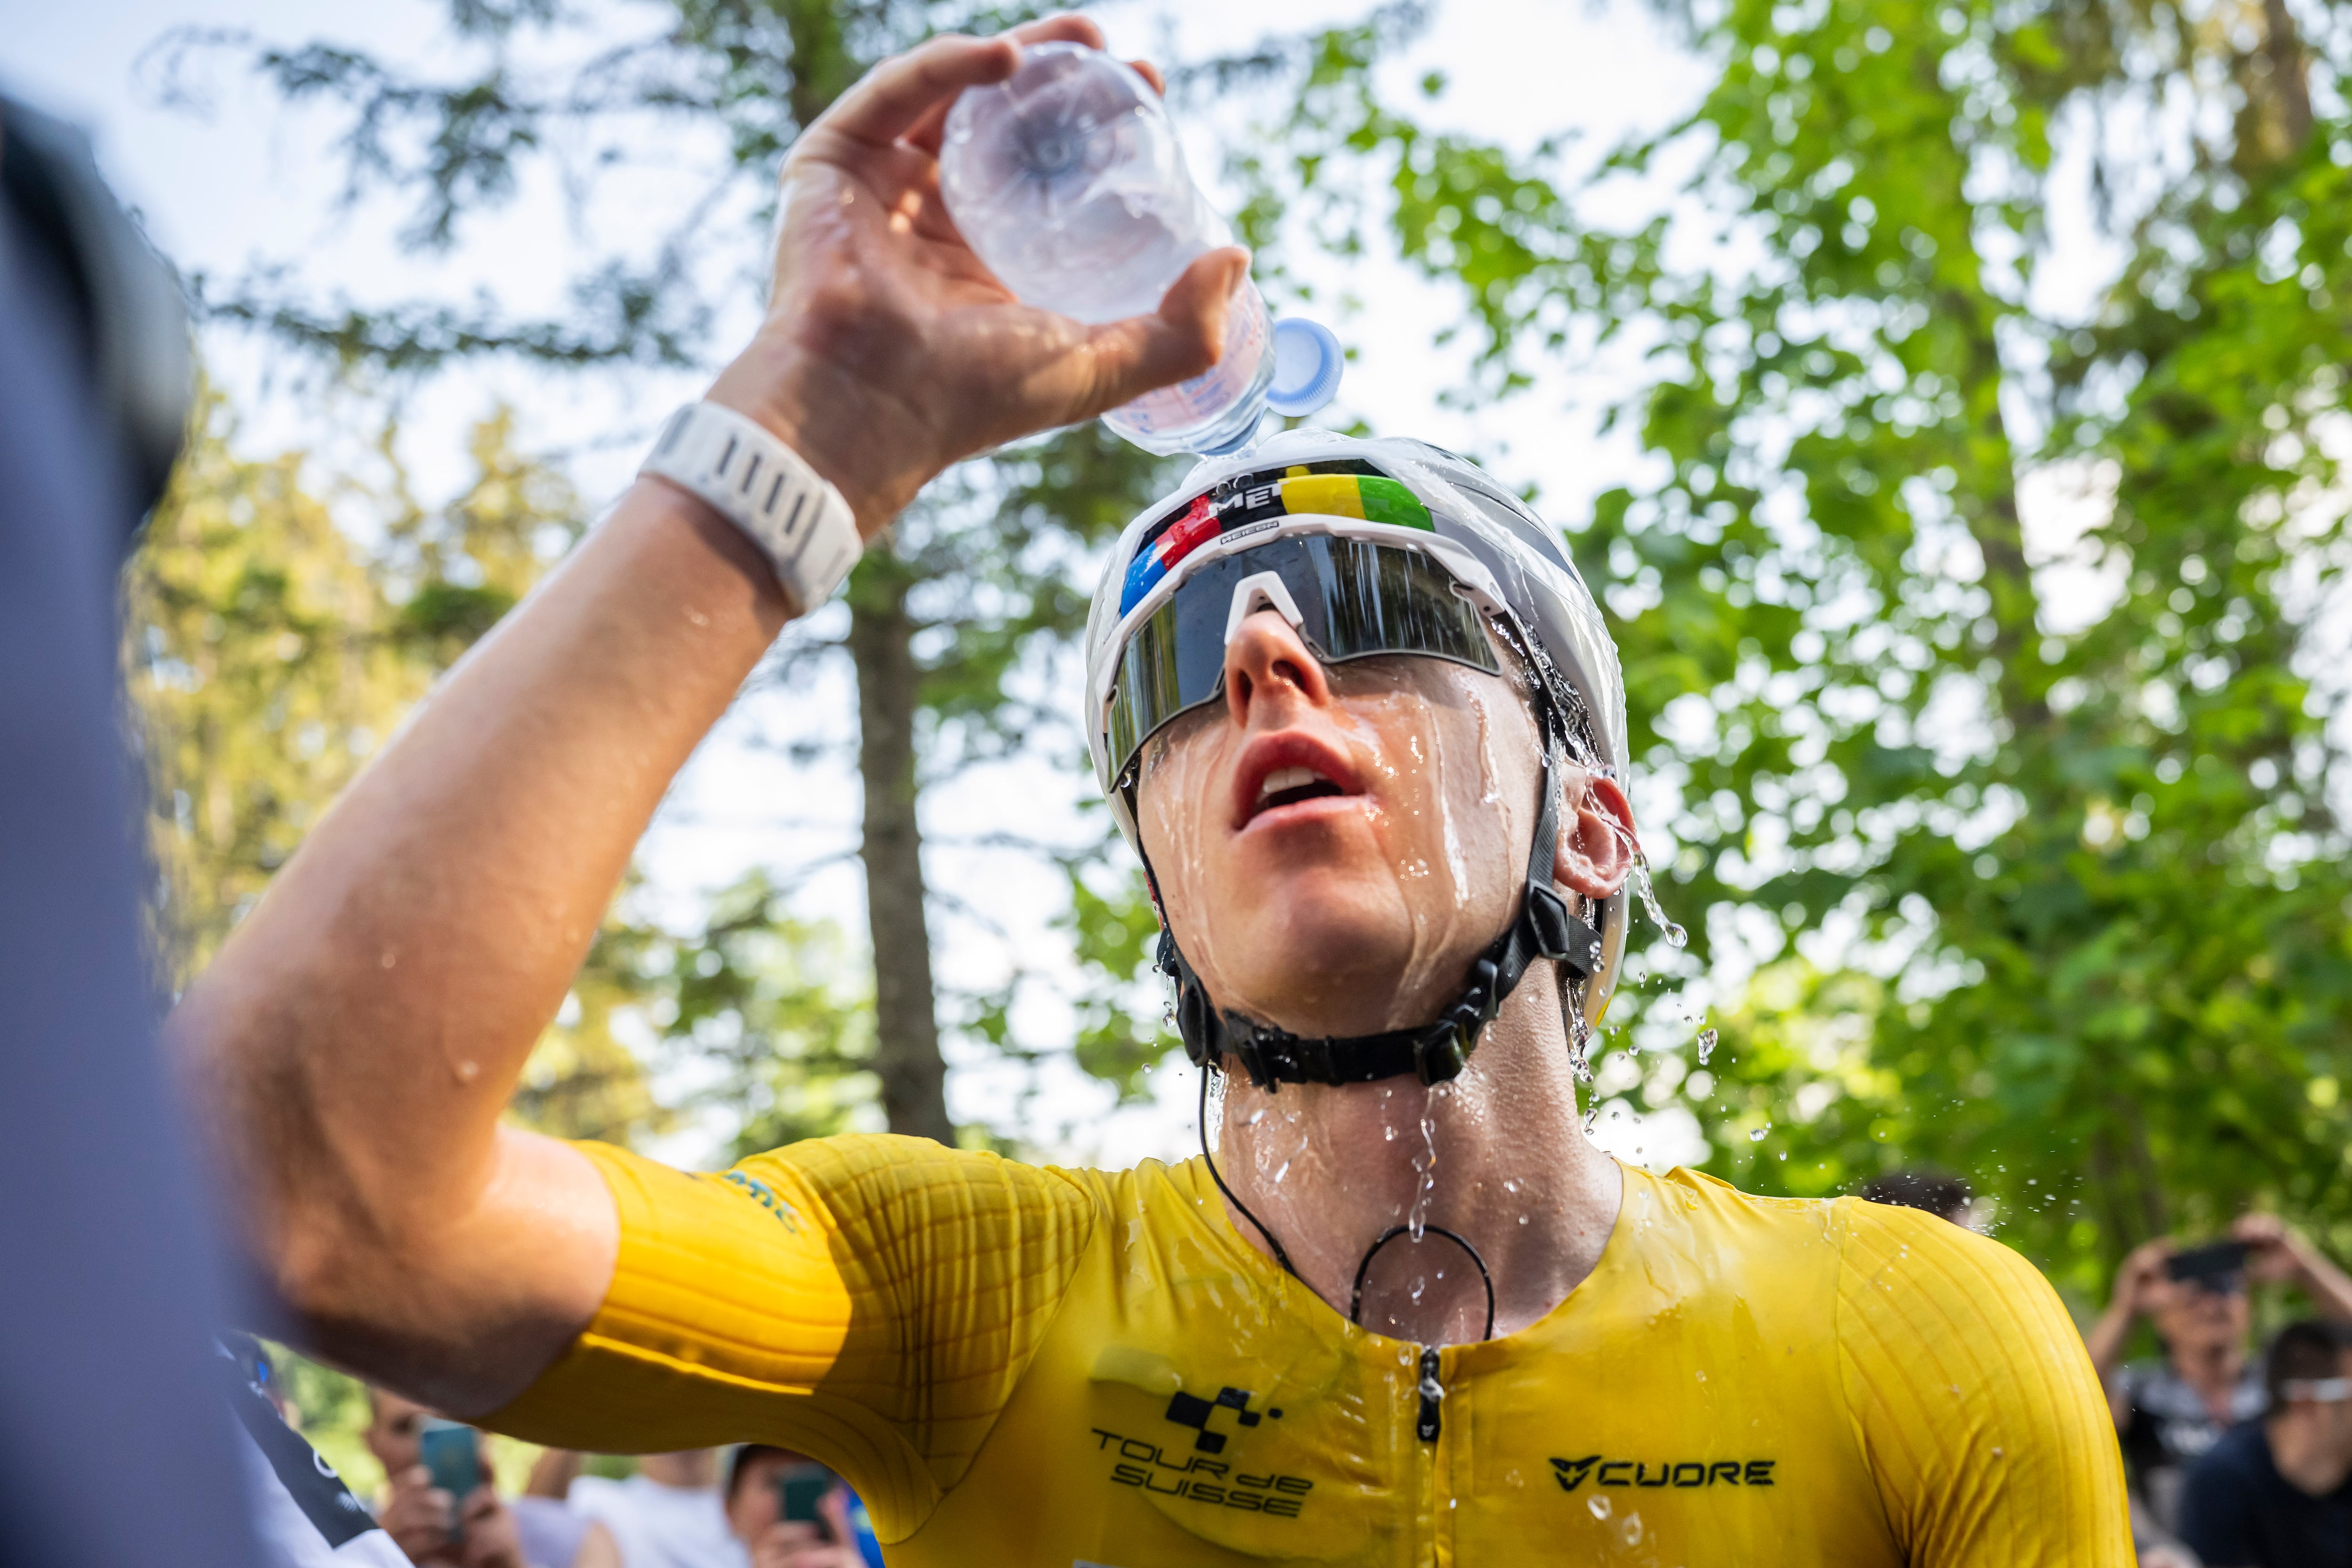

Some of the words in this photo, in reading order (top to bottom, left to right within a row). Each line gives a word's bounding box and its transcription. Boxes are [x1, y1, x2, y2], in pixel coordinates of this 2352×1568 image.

[1208, 481, 1290, 517] MET
[1091, 1427, 1230, 1480] TOUR
[1236, 1474, 1314, 1496] de
[1597, 1460, 1776, 1487] CUORE
[1110, 1463, 1303, 1519] SUISSE
